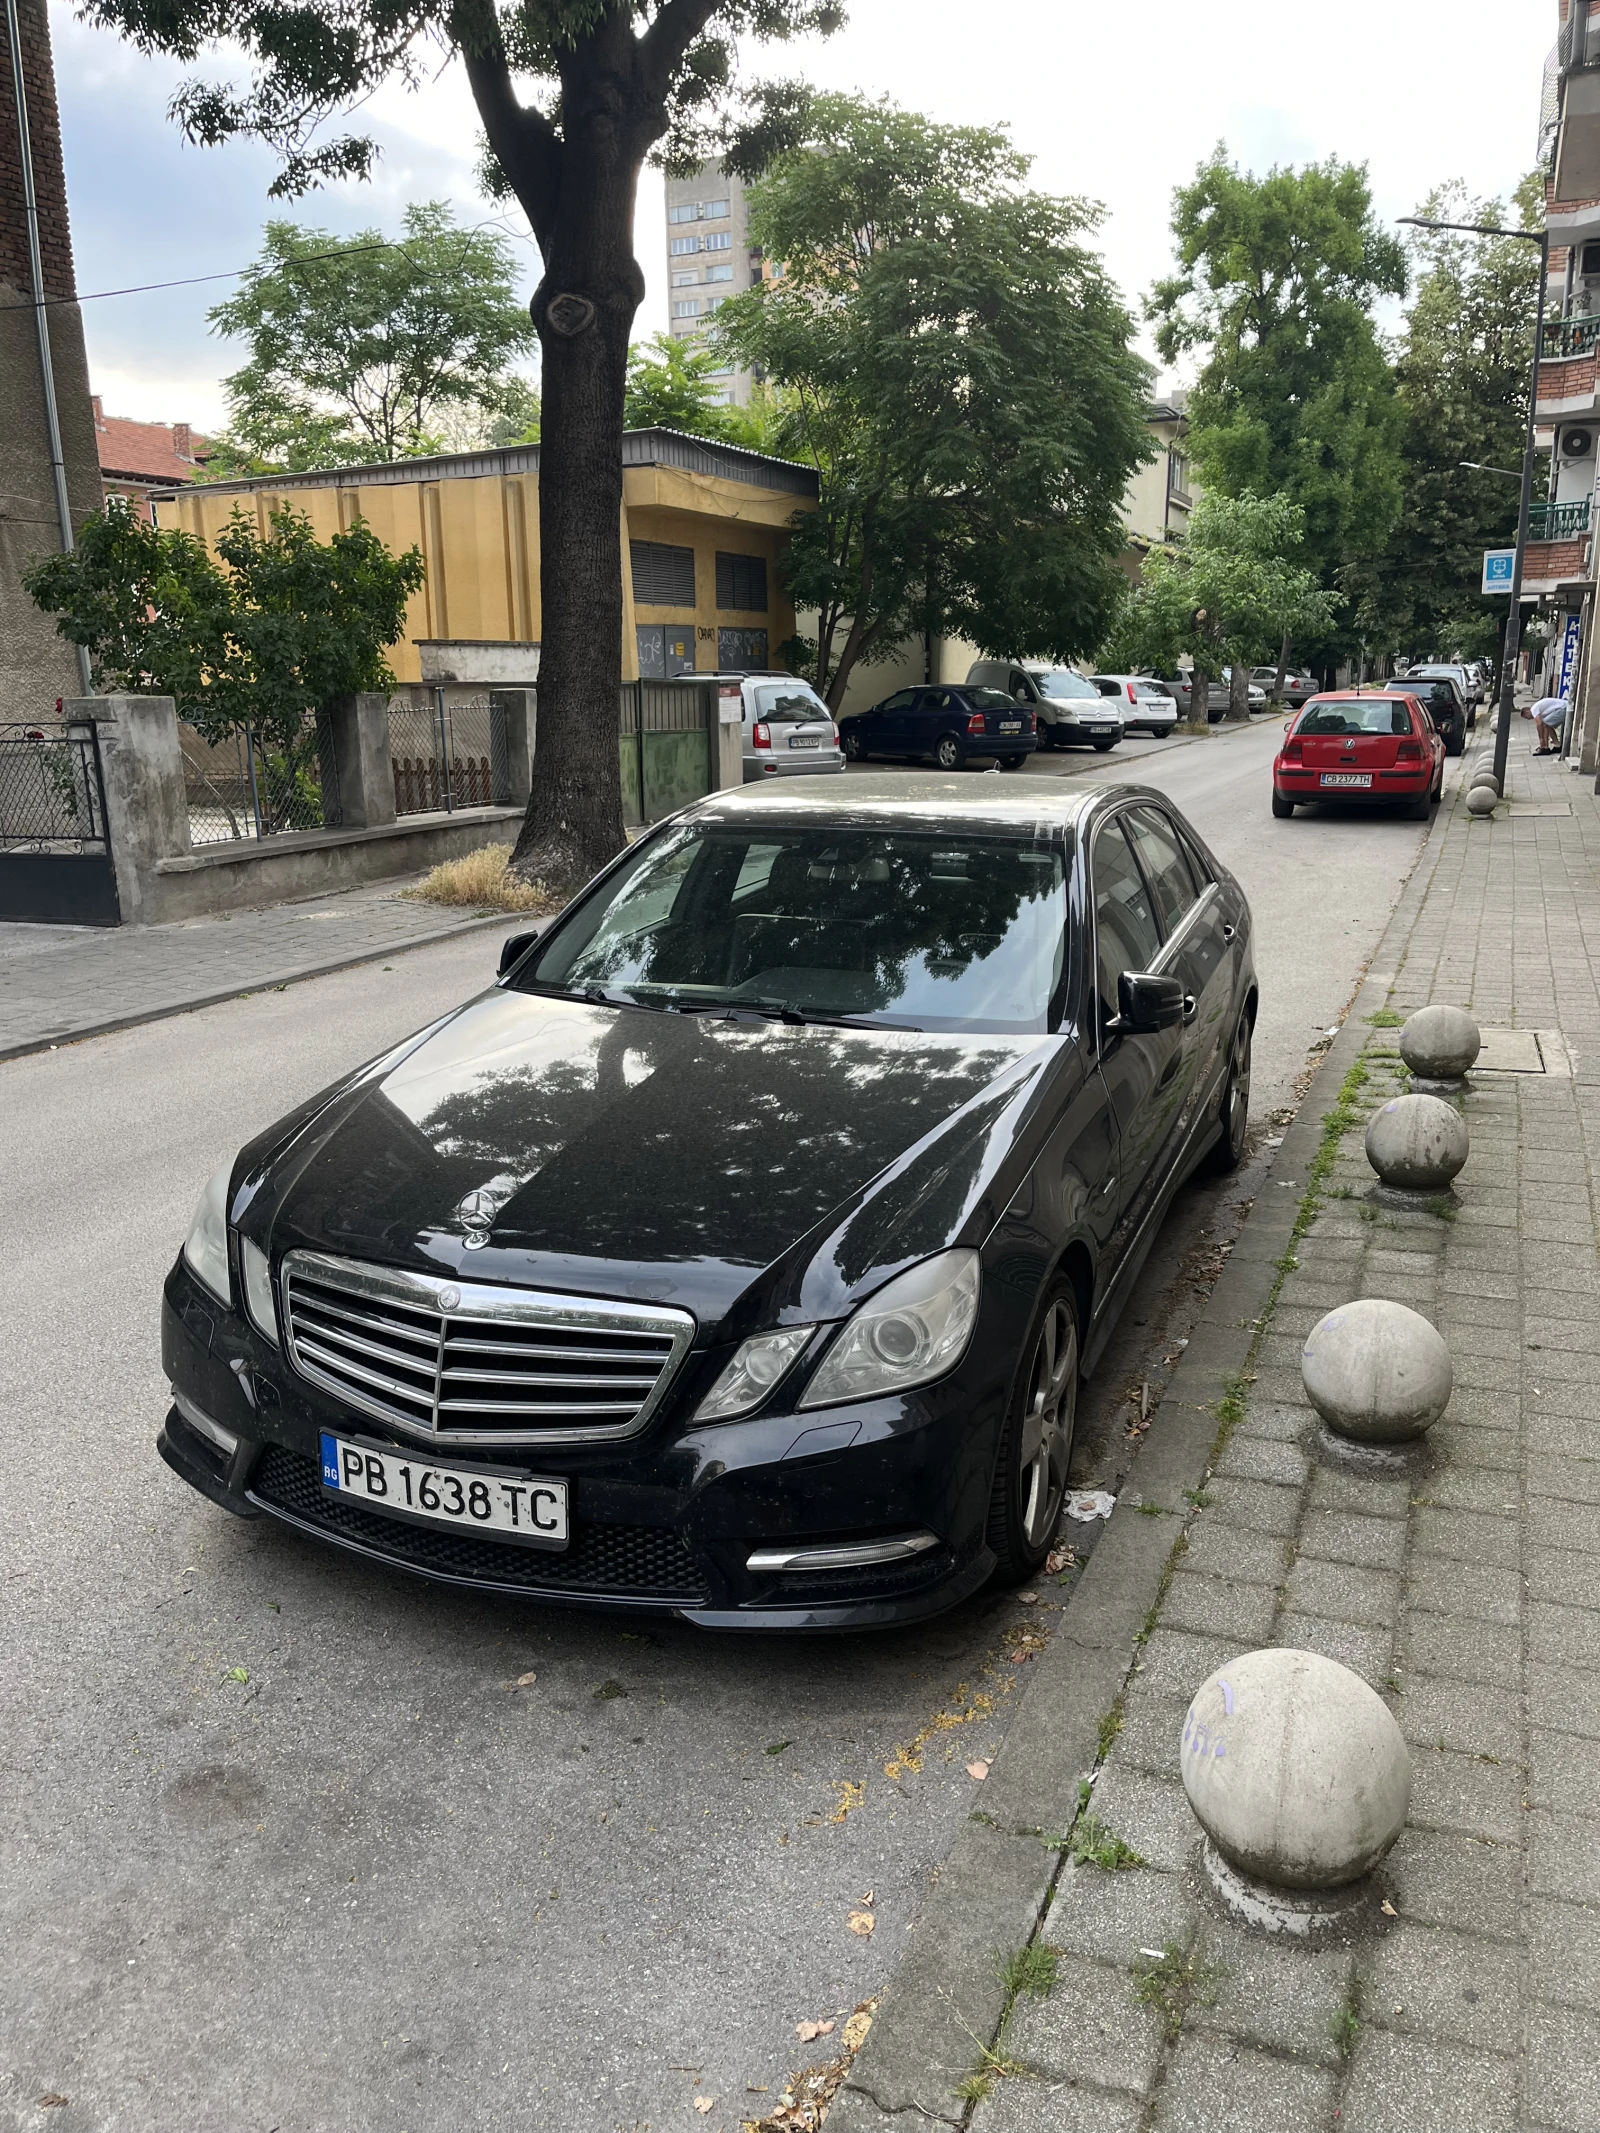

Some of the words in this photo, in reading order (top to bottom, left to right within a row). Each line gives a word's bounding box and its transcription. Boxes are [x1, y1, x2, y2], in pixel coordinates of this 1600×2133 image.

[1562, 620, 1577, 700] АПТЕКА
[1326, 775, 1337, 783] CB
[1338, 775, 1358, 783] 2377
[1359, 775, 1370, 783] TH
[342, 1447, 388, 1497] PB
[399, 1466, 492, 1520] 1638
[501, 1484, 558, 1531] TC
